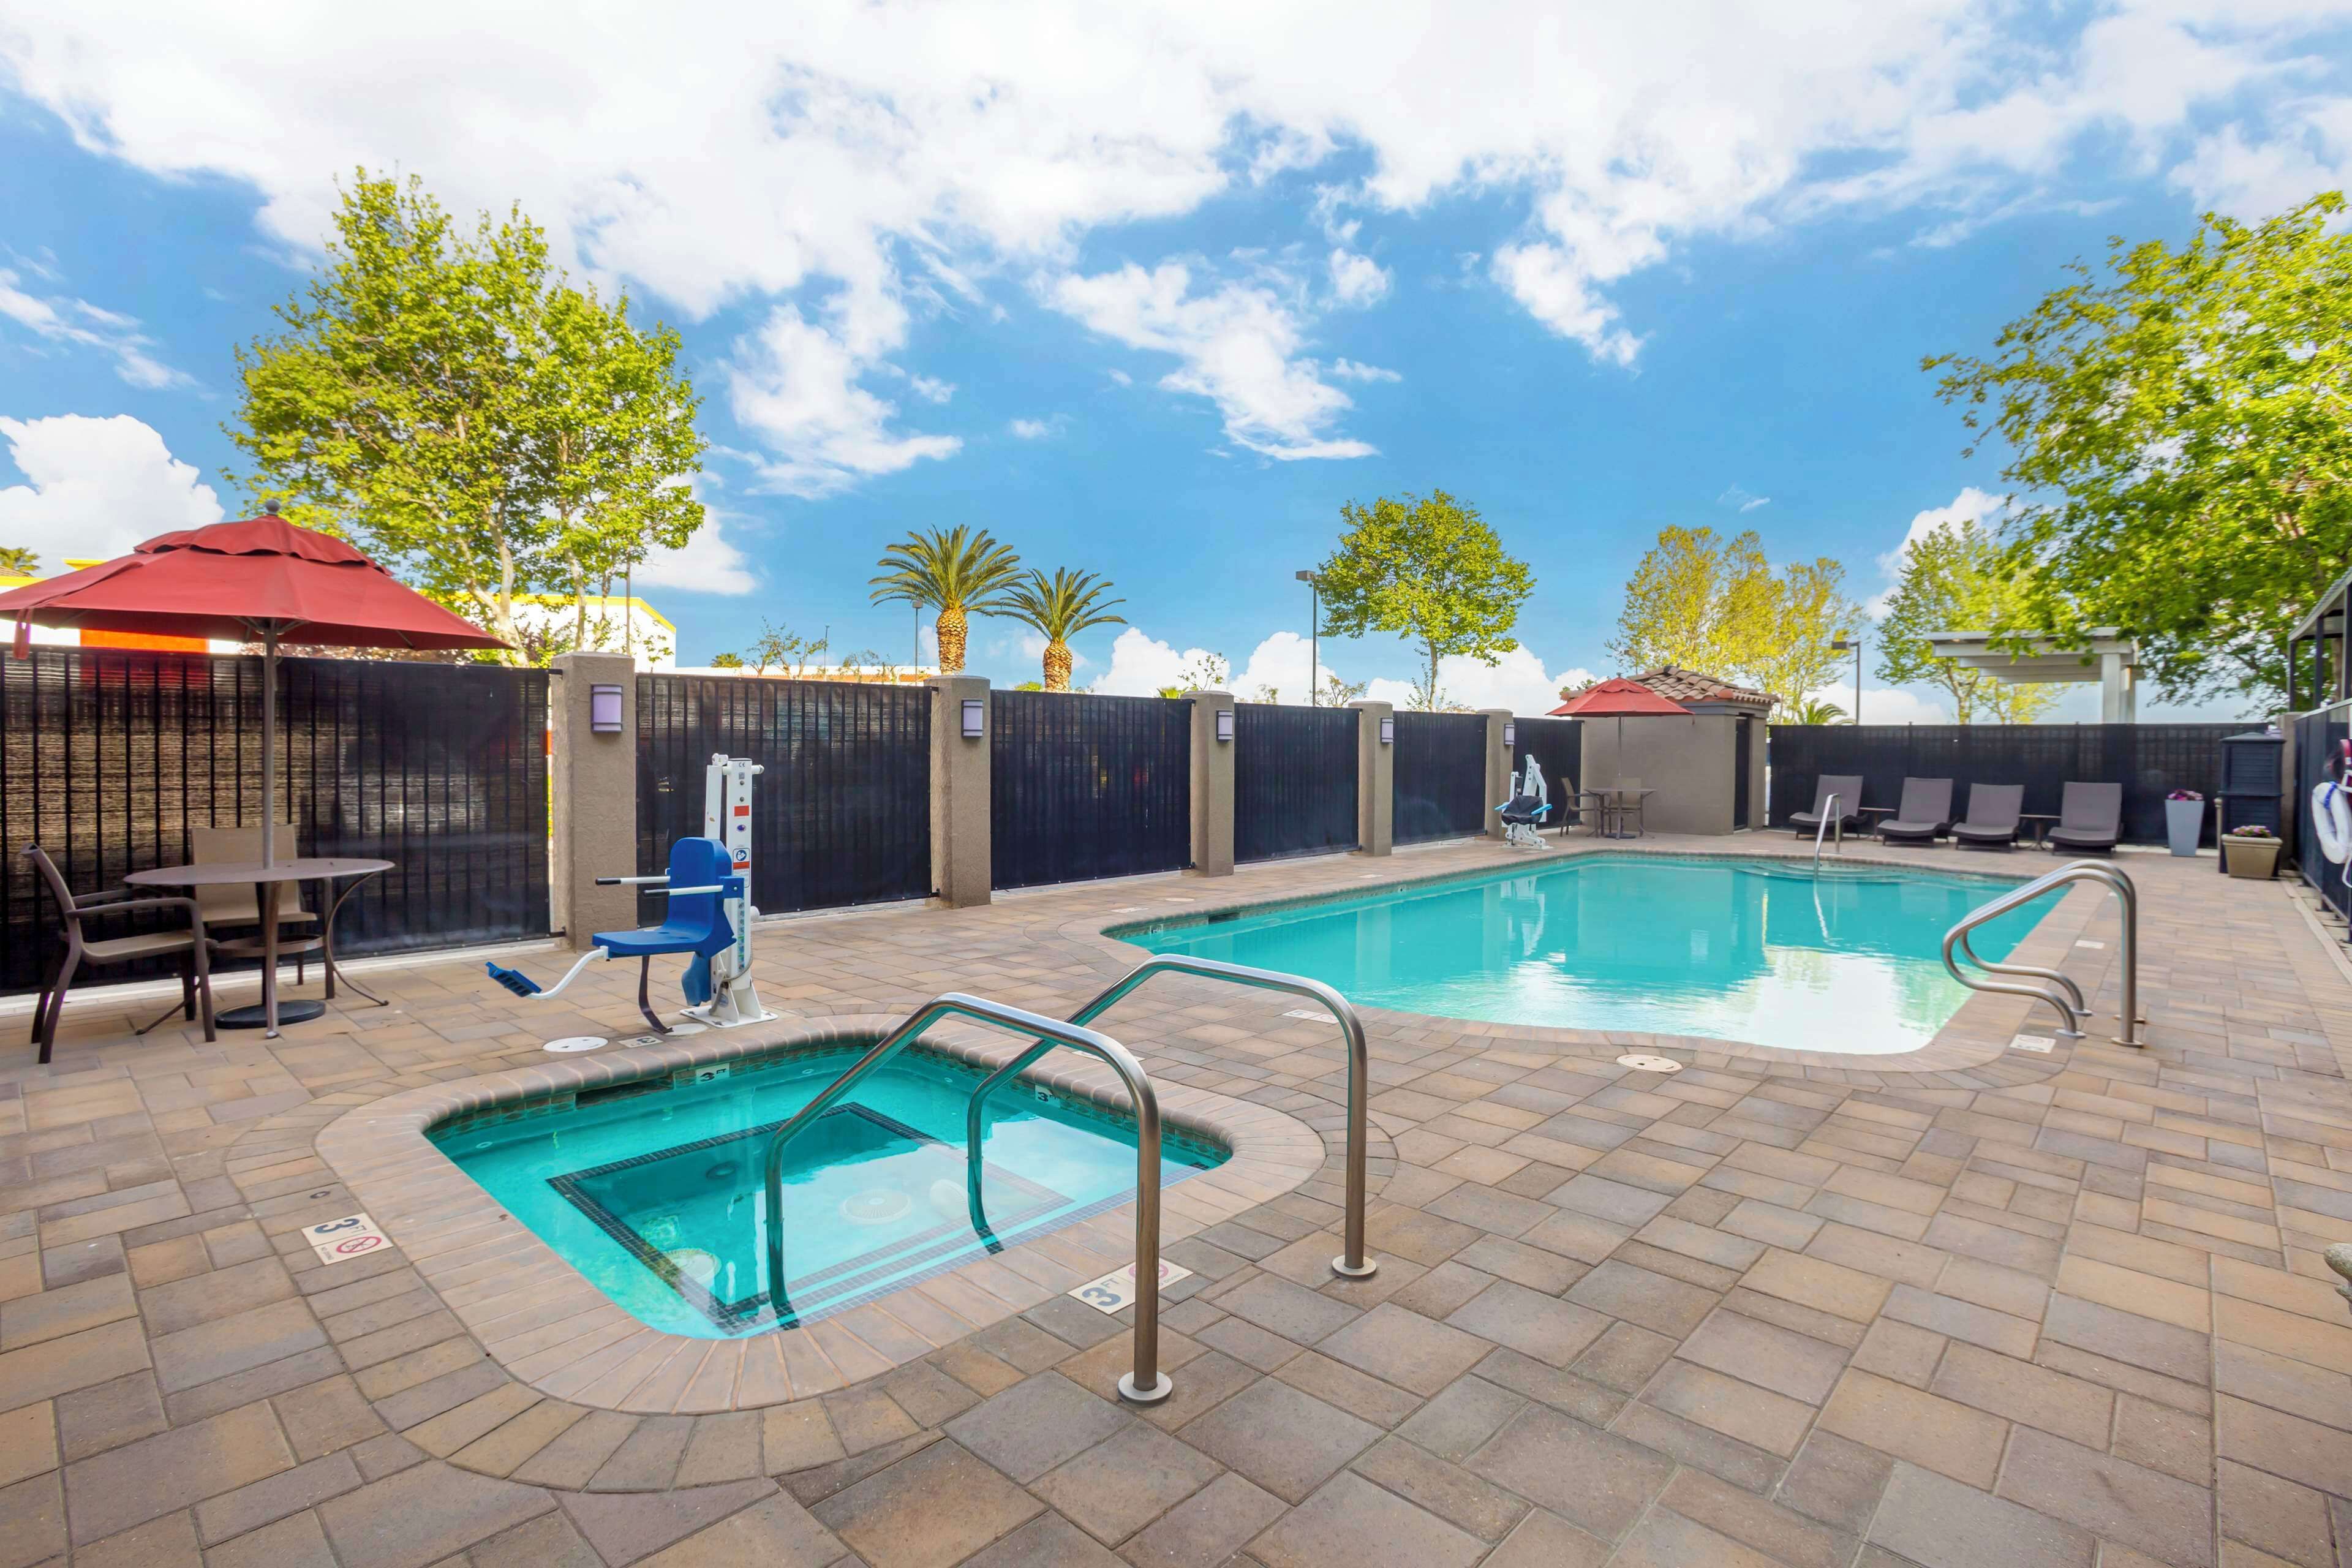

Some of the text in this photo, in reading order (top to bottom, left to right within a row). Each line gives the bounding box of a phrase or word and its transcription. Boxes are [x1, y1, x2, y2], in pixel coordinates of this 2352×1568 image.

[700, 1072, 715, 1082] 3
[1038, 1091, 1049, 1102] 3
[314, 1218, 368, 1234] 3 FT
[1163, 1273, 1185, 1284] DIVING
[1082, 1277, 1121, 1306] 3 FT
